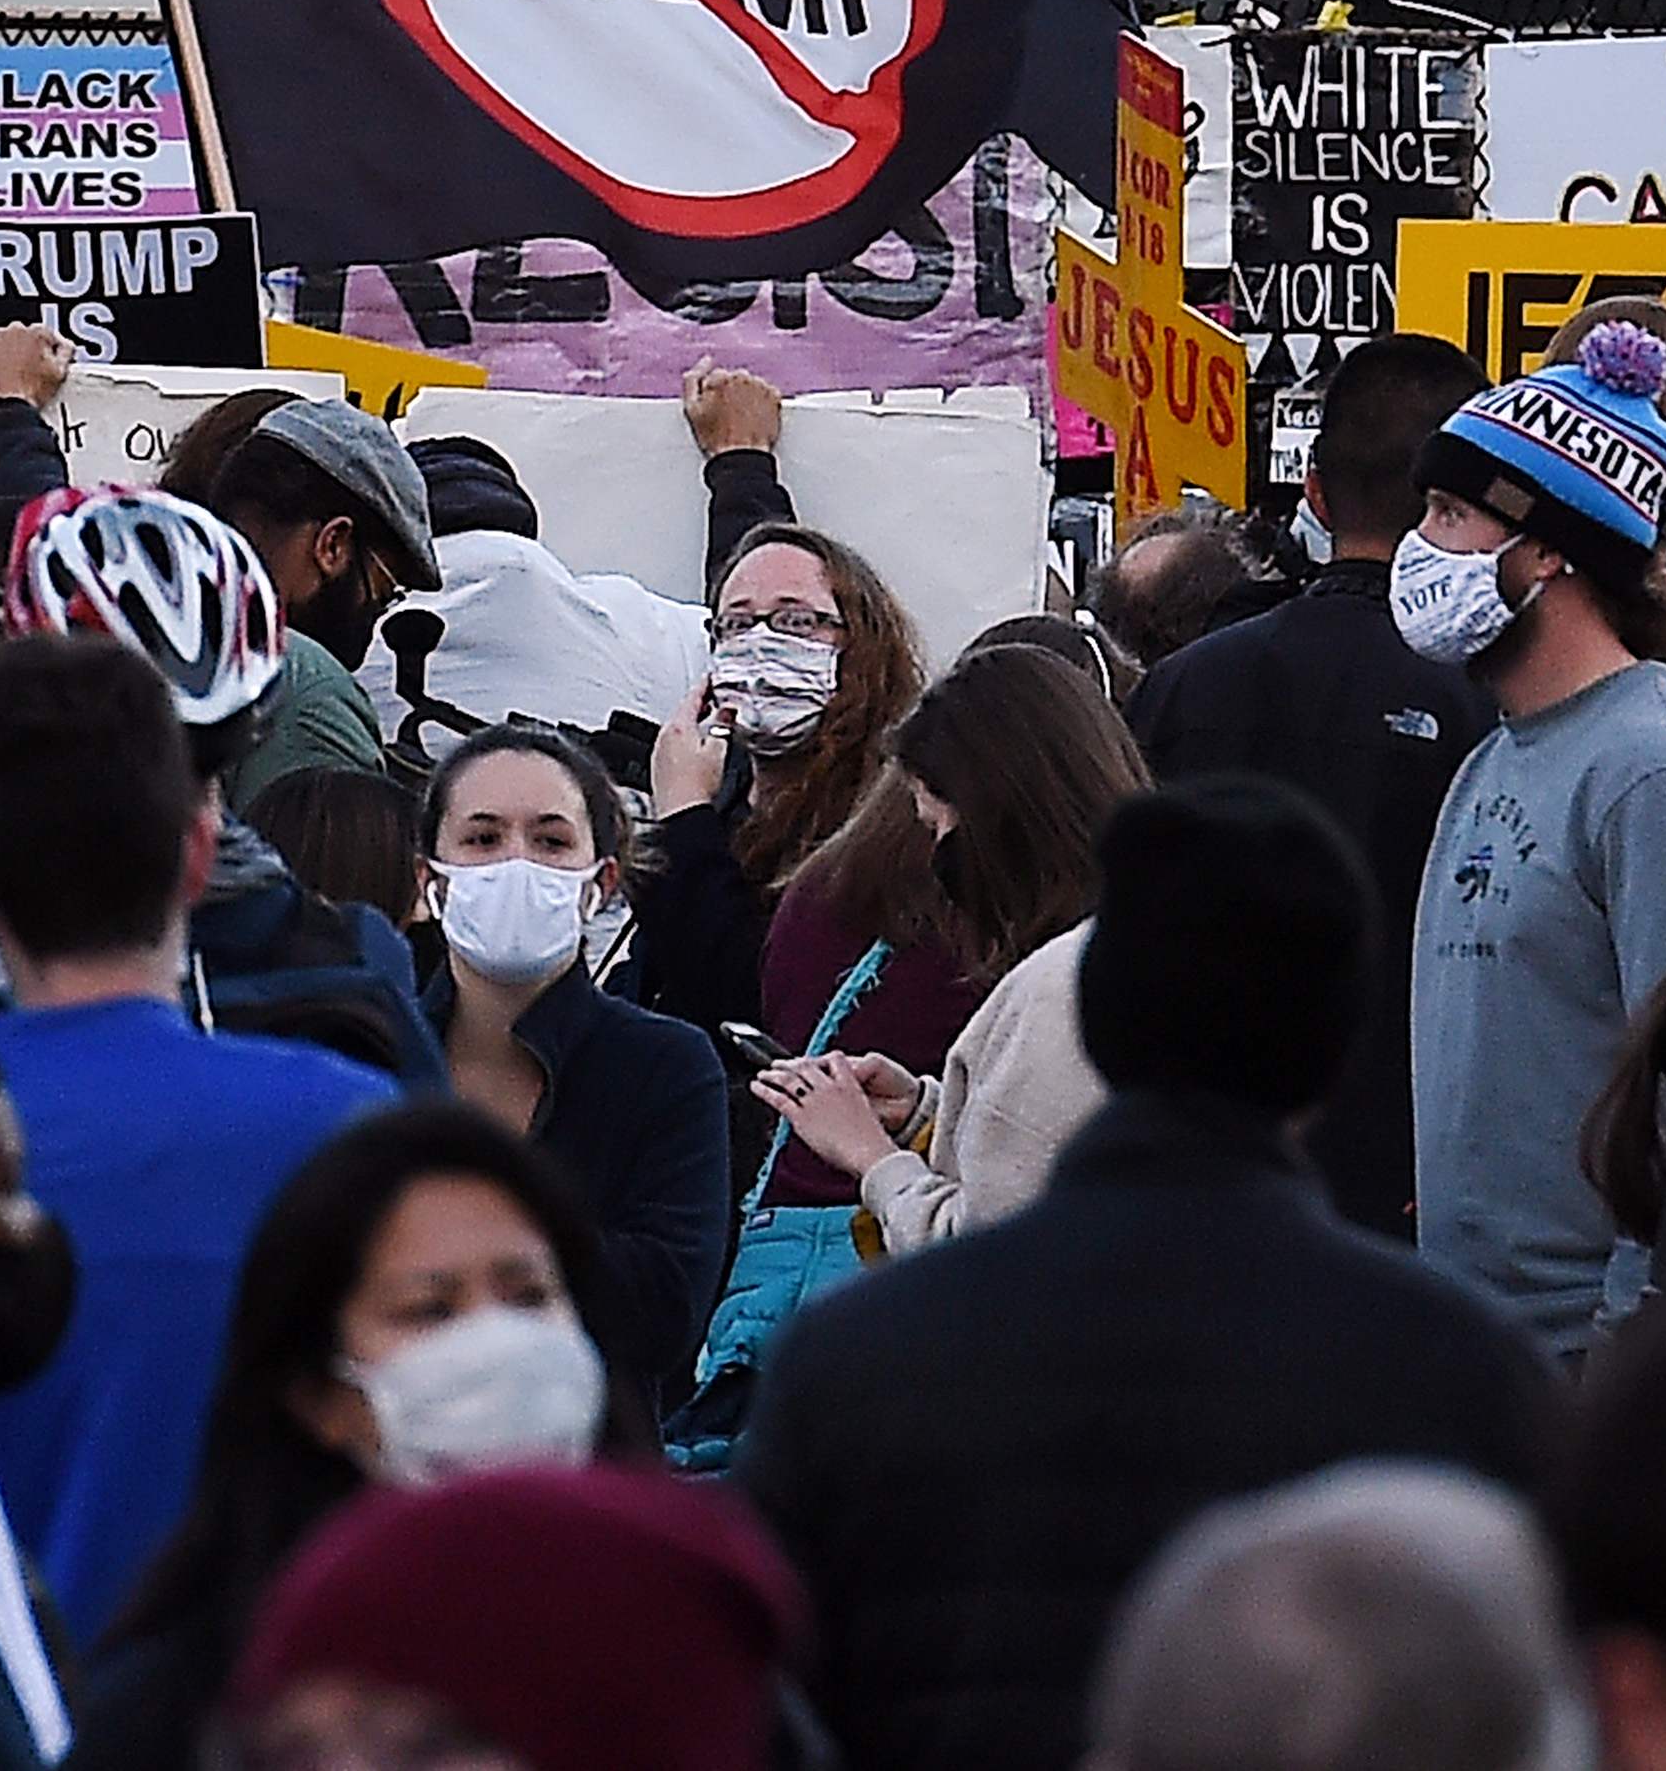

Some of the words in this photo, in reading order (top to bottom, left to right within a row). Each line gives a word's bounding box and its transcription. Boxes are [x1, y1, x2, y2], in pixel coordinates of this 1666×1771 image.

[1245, 43, 1473, 129] WHITE
[1235, 130, 1463, 185] SILENCE
[1311, 193, 1370, 255] IS
[1233, 262, 1397, 332] VIOLEN
[1063, 264, 1236, 450] JESUS
[1399, 574, 1453, 616] VOTE
